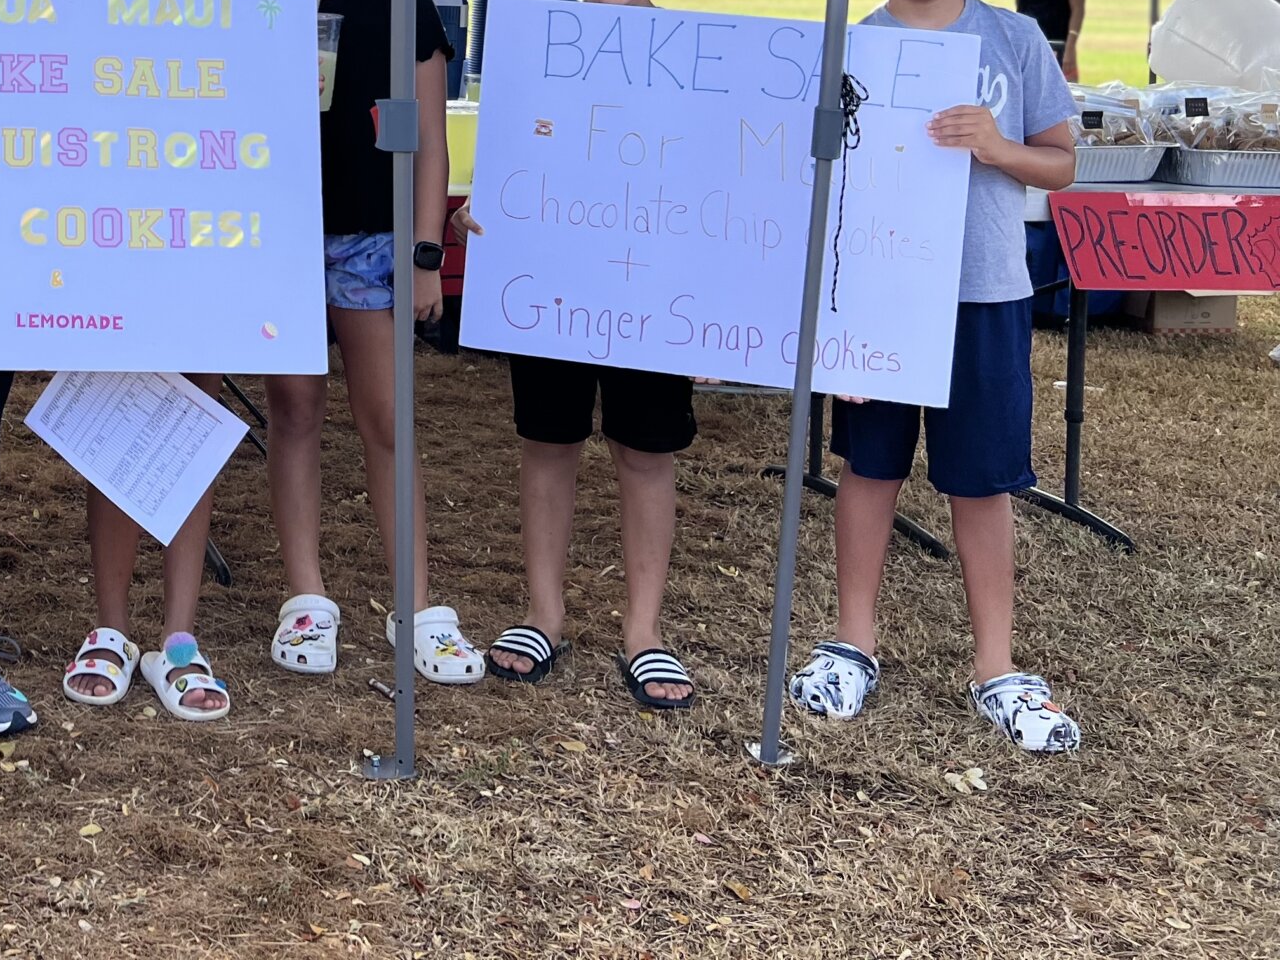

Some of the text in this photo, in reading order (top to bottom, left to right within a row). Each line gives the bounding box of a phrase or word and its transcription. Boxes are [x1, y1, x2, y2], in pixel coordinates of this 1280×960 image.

[93, 56, 227, 99] SALE
[544, 9, 737, 94] BAKE
[588, 104, 685, 168] For
[20, 205, 262, 249] COOKIES!
[500, 169, 935, 262] Chocolate Chip ookies
[1059, 205, 1255, 282] PRE-ORDER
[49, 269, 64, 289] &
[501, 274, 652, 360] Ginger
[665, 294, 763, 367] Snap
